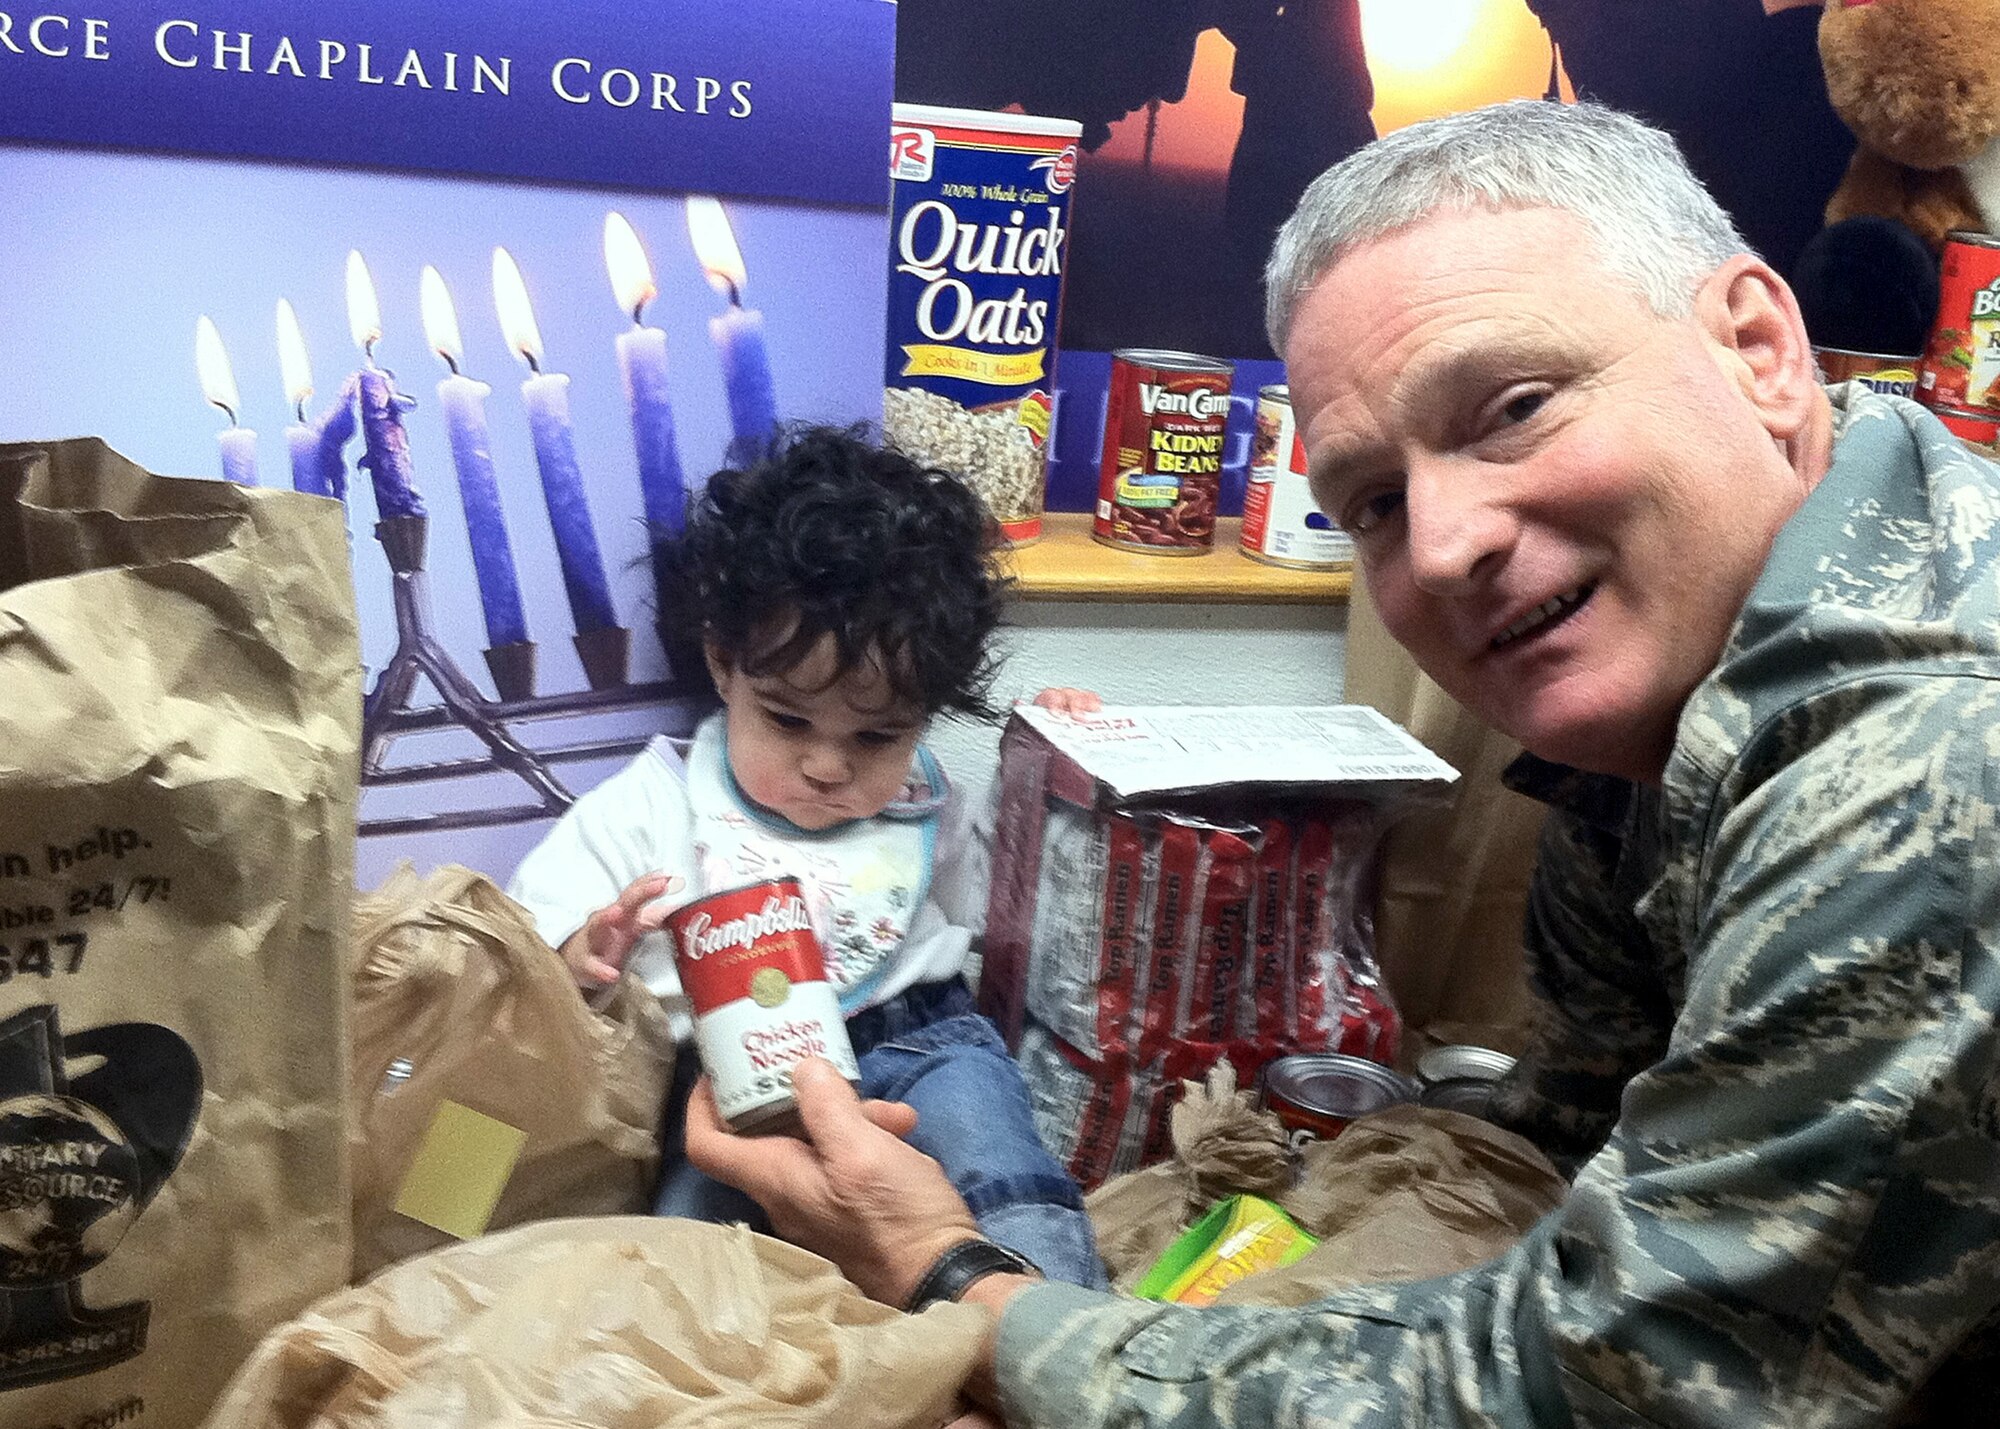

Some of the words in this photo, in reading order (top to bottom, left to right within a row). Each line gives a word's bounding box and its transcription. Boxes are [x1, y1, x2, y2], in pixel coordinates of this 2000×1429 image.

[155, 20, 512, 96] CHAPLAIN
[551, 58, 753, 119] CORPS
[896, 200, 1066, 282] Quick
[916, 278, 1049, 345] Oats
[48, 826, 153, 874] help.
[68, 875, 171, 918] 24/7!
[1107, 862, 1131, 941] Ramen
[1157, 874, 1181, 950] Ramen
[1258, 871, 1280, 946] Ramen
[1104, 945, 1125, 982] Top
[1153, 954, 1175, 993] Top
[741, 1020, 824, 1052] Chicken
